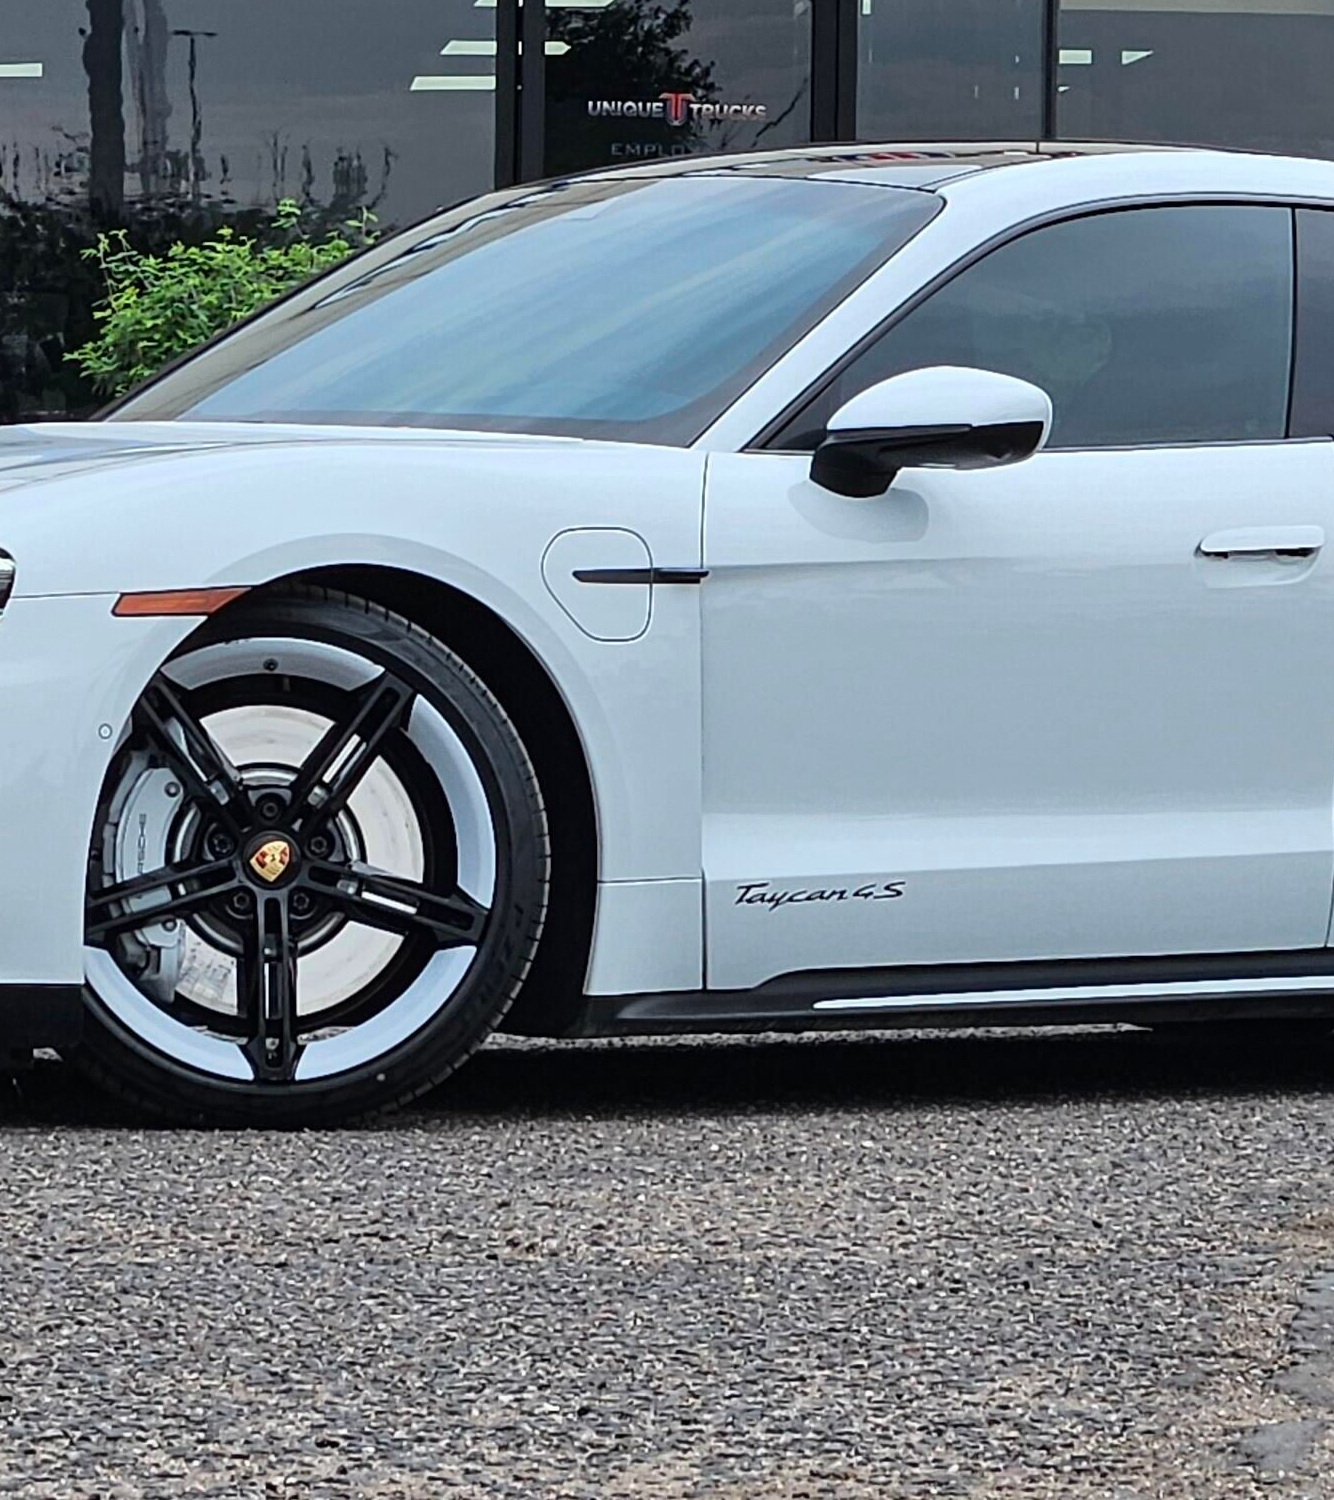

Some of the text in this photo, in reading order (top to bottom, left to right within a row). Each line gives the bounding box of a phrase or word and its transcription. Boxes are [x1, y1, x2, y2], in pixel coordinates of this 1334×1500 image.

[587, 100, 664, 118] UNIQUE
[689, 103, 767, 121] TRUCKS
[610, 142, 697, 157] EMPLO
[734, 882, 848, 912] Taycan
